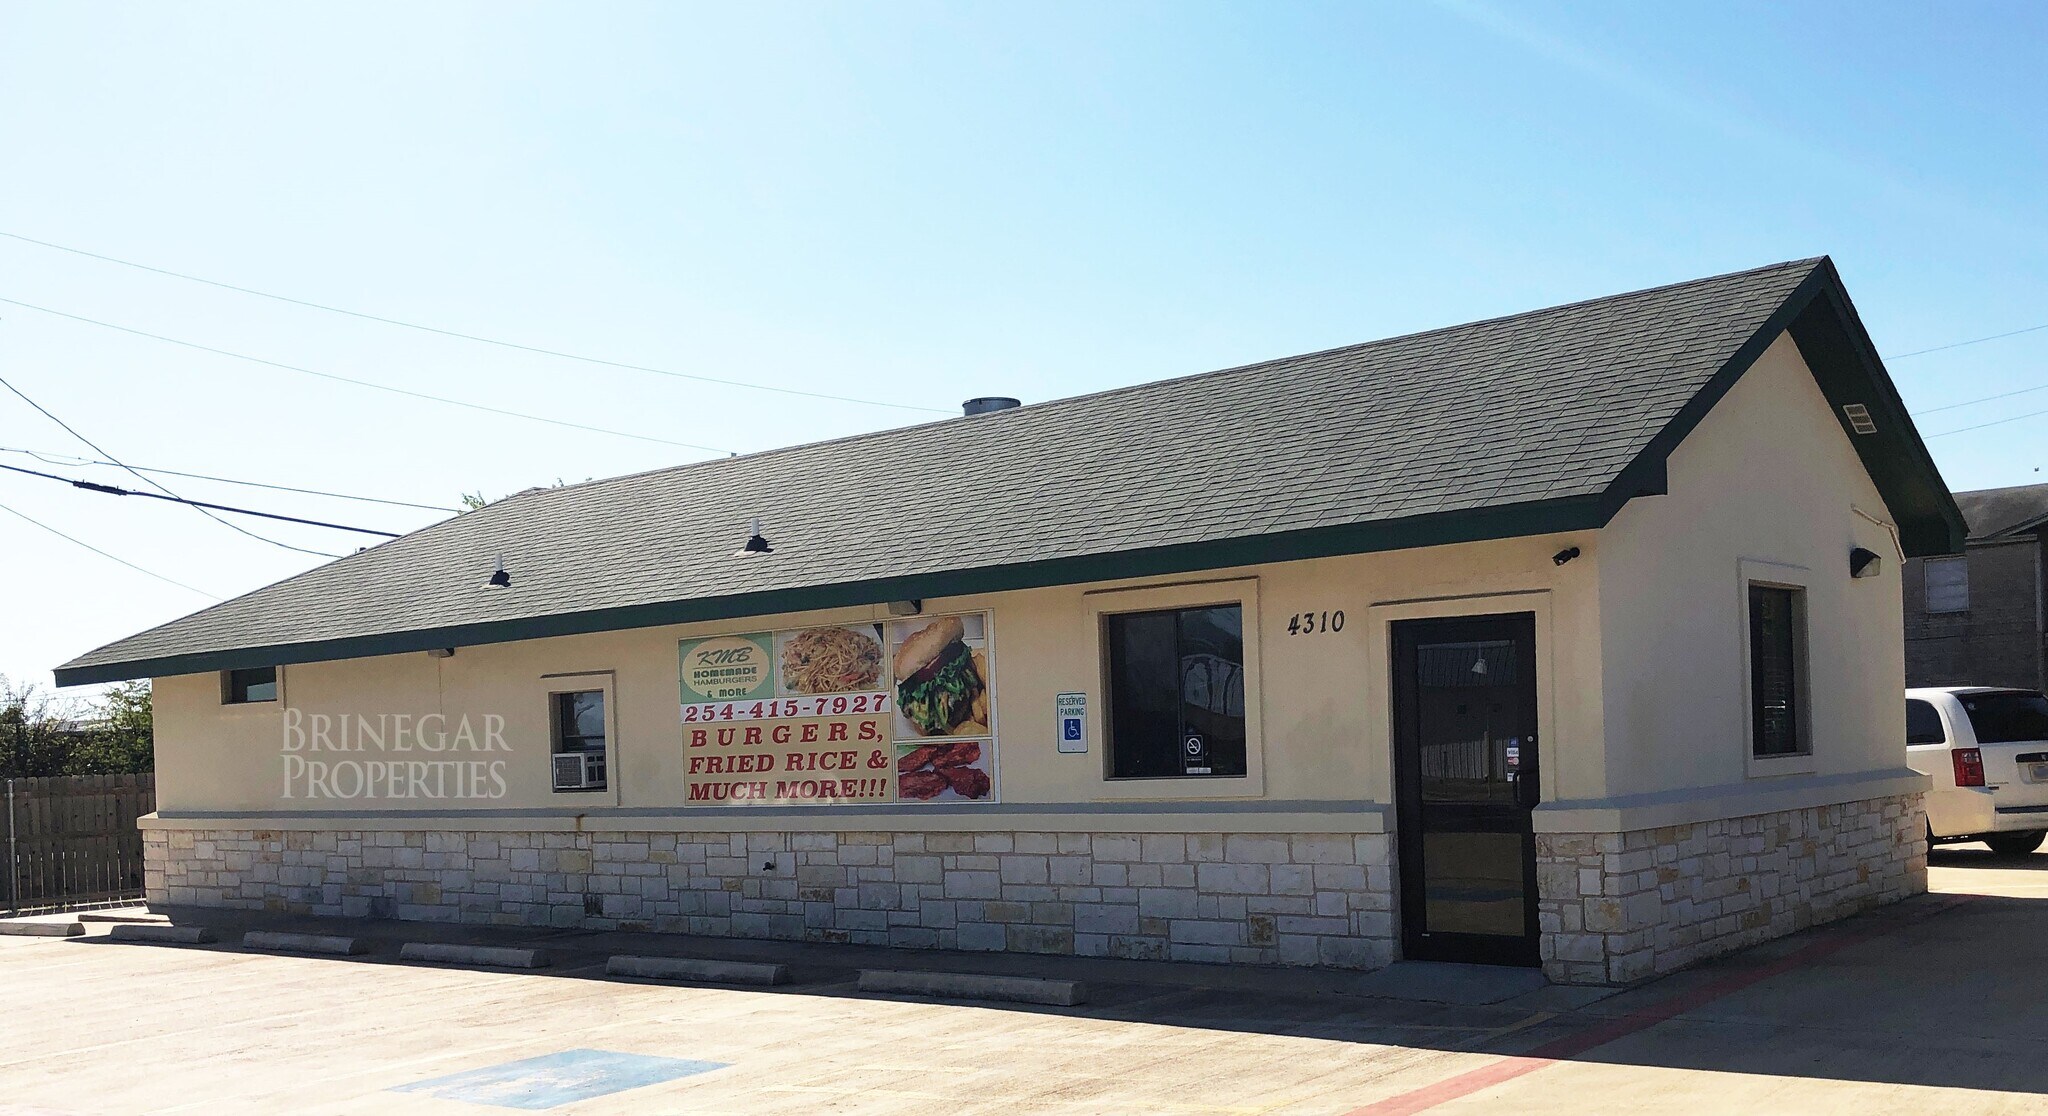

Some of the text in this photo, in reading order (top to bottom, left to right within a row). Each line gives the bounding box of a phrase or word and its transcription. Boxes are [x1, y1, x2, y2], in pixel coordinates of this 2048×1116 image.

[1287, 610, 1345, 636] 4310
[697, 646, 753, 666] KMB
[694, 666, 757, 679] HOMEMADE
[694, 675, 758, 686] HAMBURGERS
[719, 688, 747, 698] MORE
[1059, 698, 1086, 706] RESERVED
[685, 695, 886, 722] 254-415-7927
[1060, 708, 1084, 716] PARKING
[690, 721, 883, 747] BURGERS,
[689, 749, 888, 774] FRIED RICE &
[688, 778, 888, 801] MUCH MORE!!!
